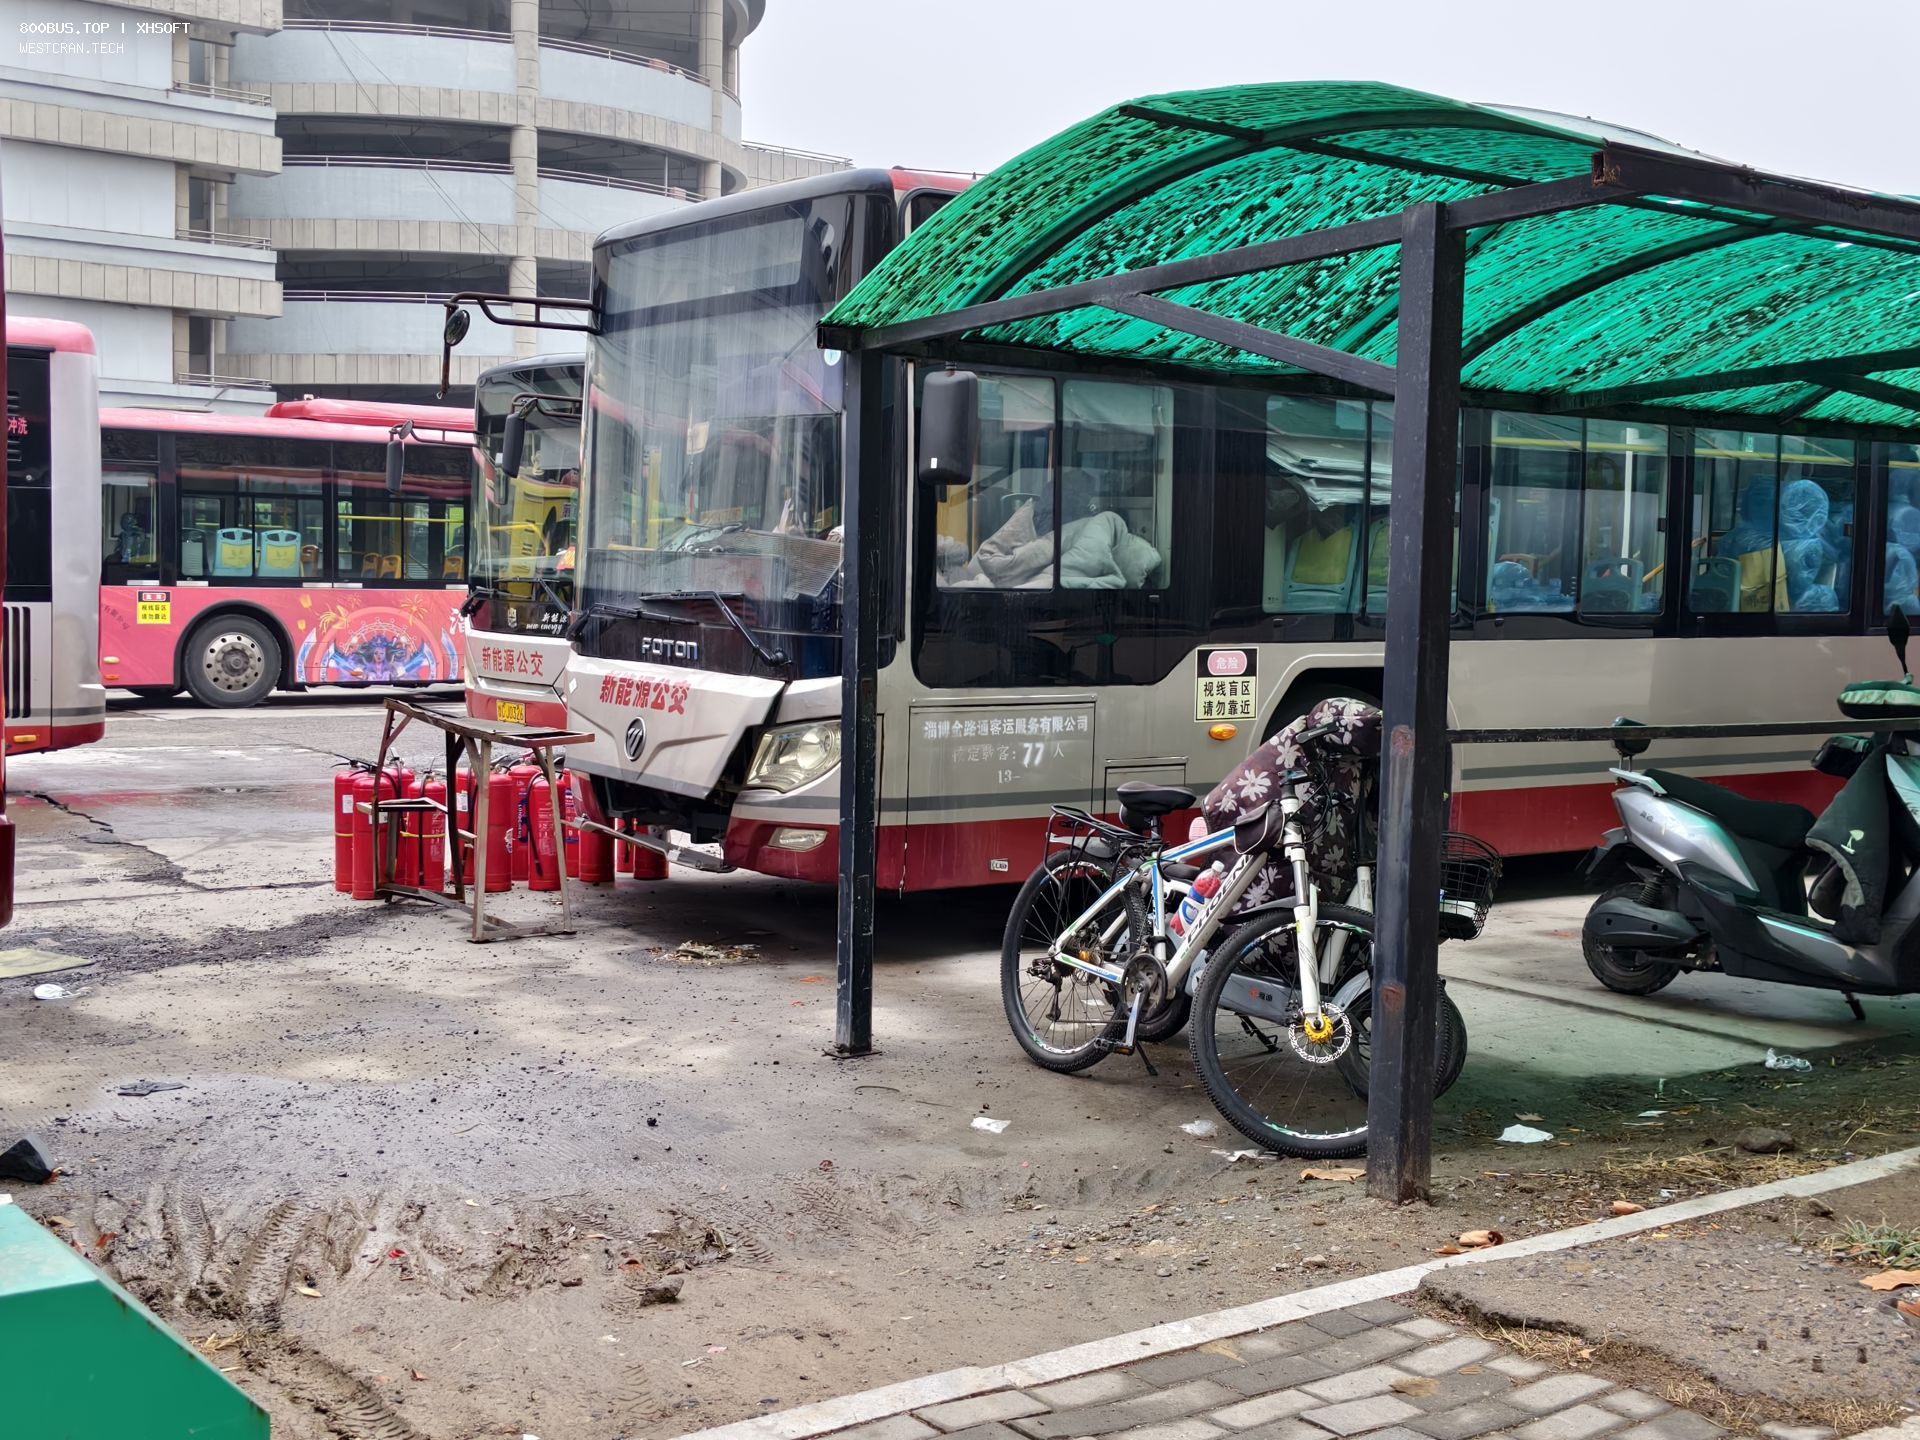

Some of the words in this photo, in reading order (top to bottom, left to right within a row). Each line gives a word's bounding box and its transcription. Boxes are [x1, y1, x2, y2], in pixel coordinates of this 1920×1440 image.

[7, 416, 28, 435] 冲洗
[540, 623, 563, 635] energy
[641, 637, 698, 660] FOTON
[482, 647, 543, 675] 新能源公交
[1216, 656, 1239, 669] 危险
[599, 671, 690, 714] 新能源公交
[1203, 680, 1251, 697] 视线盲区
[1203, 699, 1251, 717] 请勿靠近
[923, 715, 1088, 739] 淄博金路通客运服务有限公司
[1023, 743, 1045, 767] 77
[1053, 744, 1065, 759] 人
[1187, 853, 1254, 944] PHOENI
